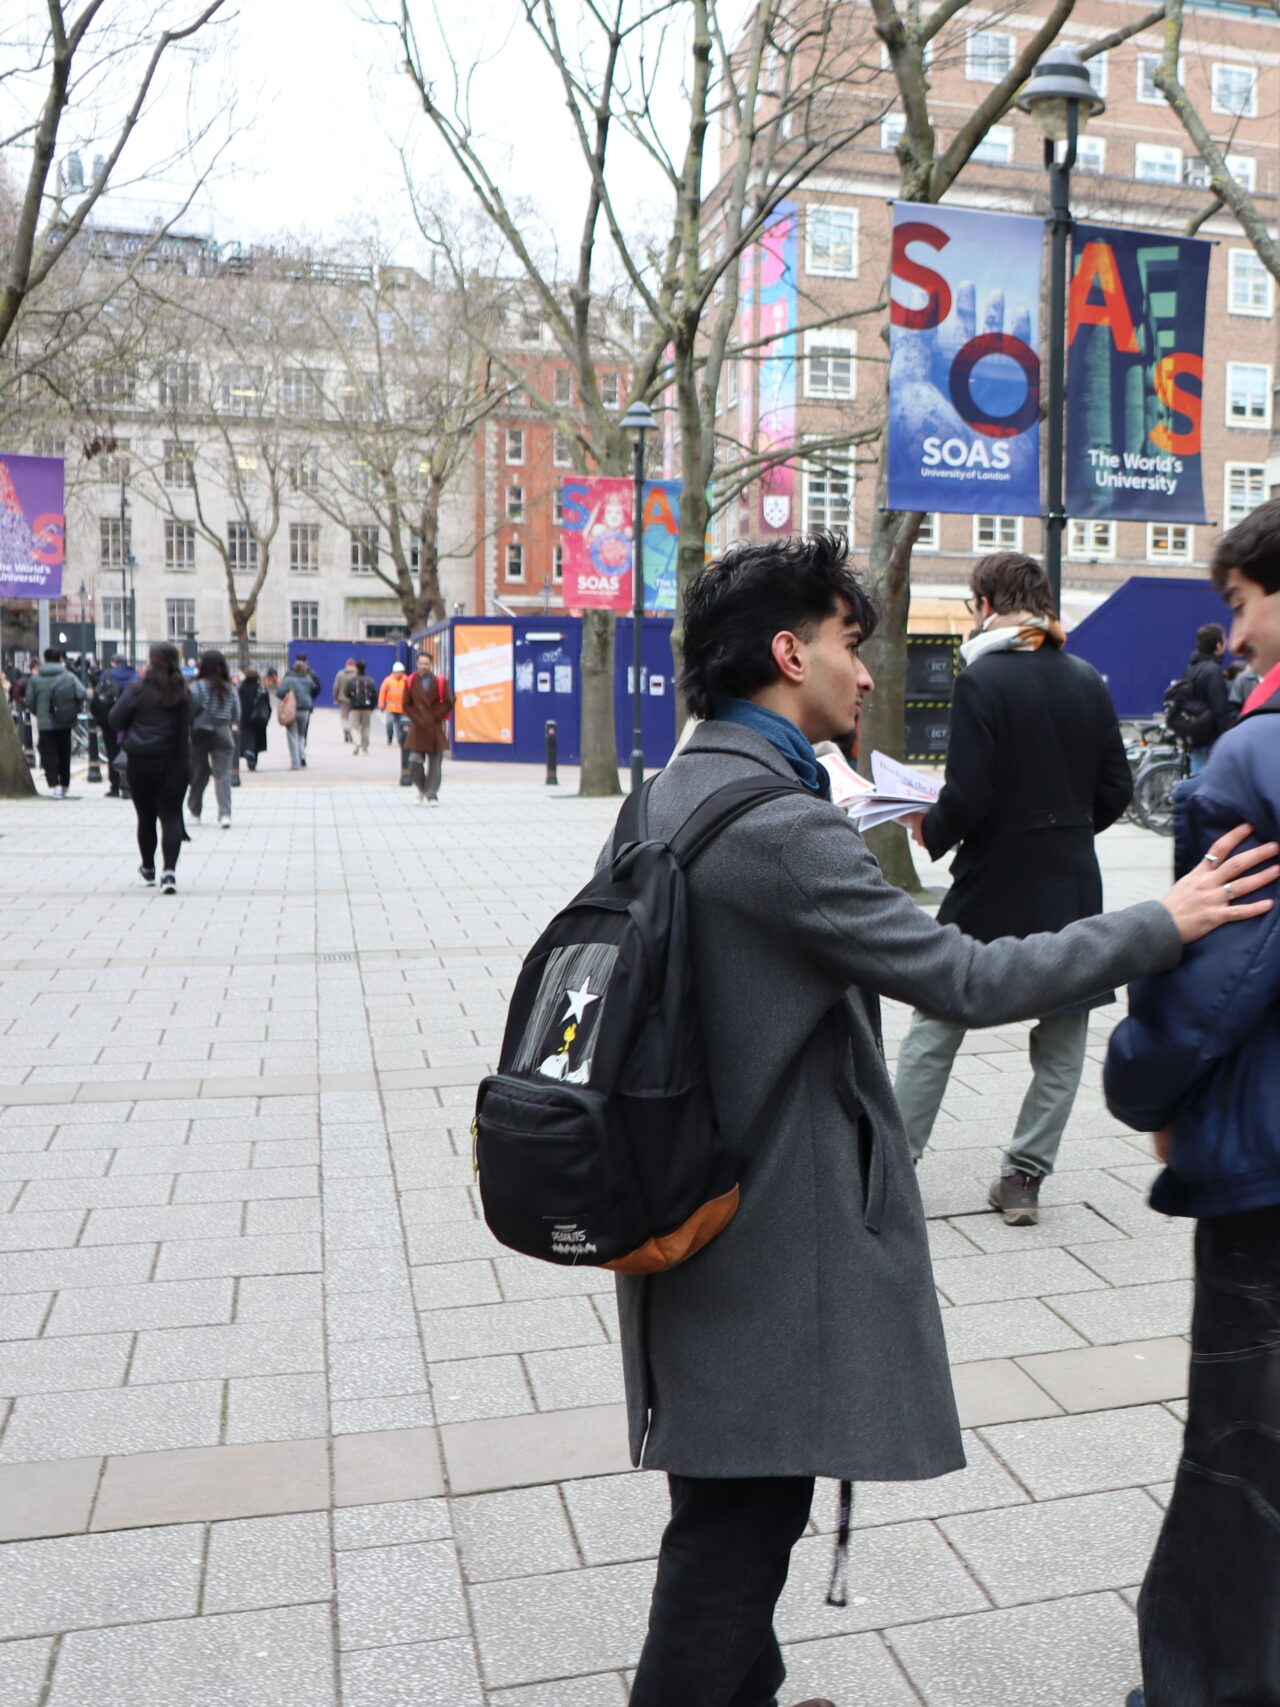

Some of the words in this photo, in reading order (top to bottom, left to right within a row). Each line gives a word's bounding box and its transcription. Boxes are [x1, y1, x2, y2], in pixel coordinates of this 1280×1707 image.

[890, 221, 952, 330] S
[1068, 242, 1141, 353] A
[949, 332, 1041, 438] O
[1147, 352, 1203, 456] S
[921, 467, 966, 480] University
[966, 470, 976, 479] of
[977, 471, 1011, 481] London
[922, 436, 1011, 469] SOAS
[1087, 448, 1120, 468] The
[1123, 452, 1183, 474] World's
[1095, 470, 1178, 495] University
[562, 484, 590, 531] S
[643, 487, 680, 536] A
[32, 512, 64, 565] S
[14, 562, 51, 575] World's
[577, 575, 619, 590] SOAS
